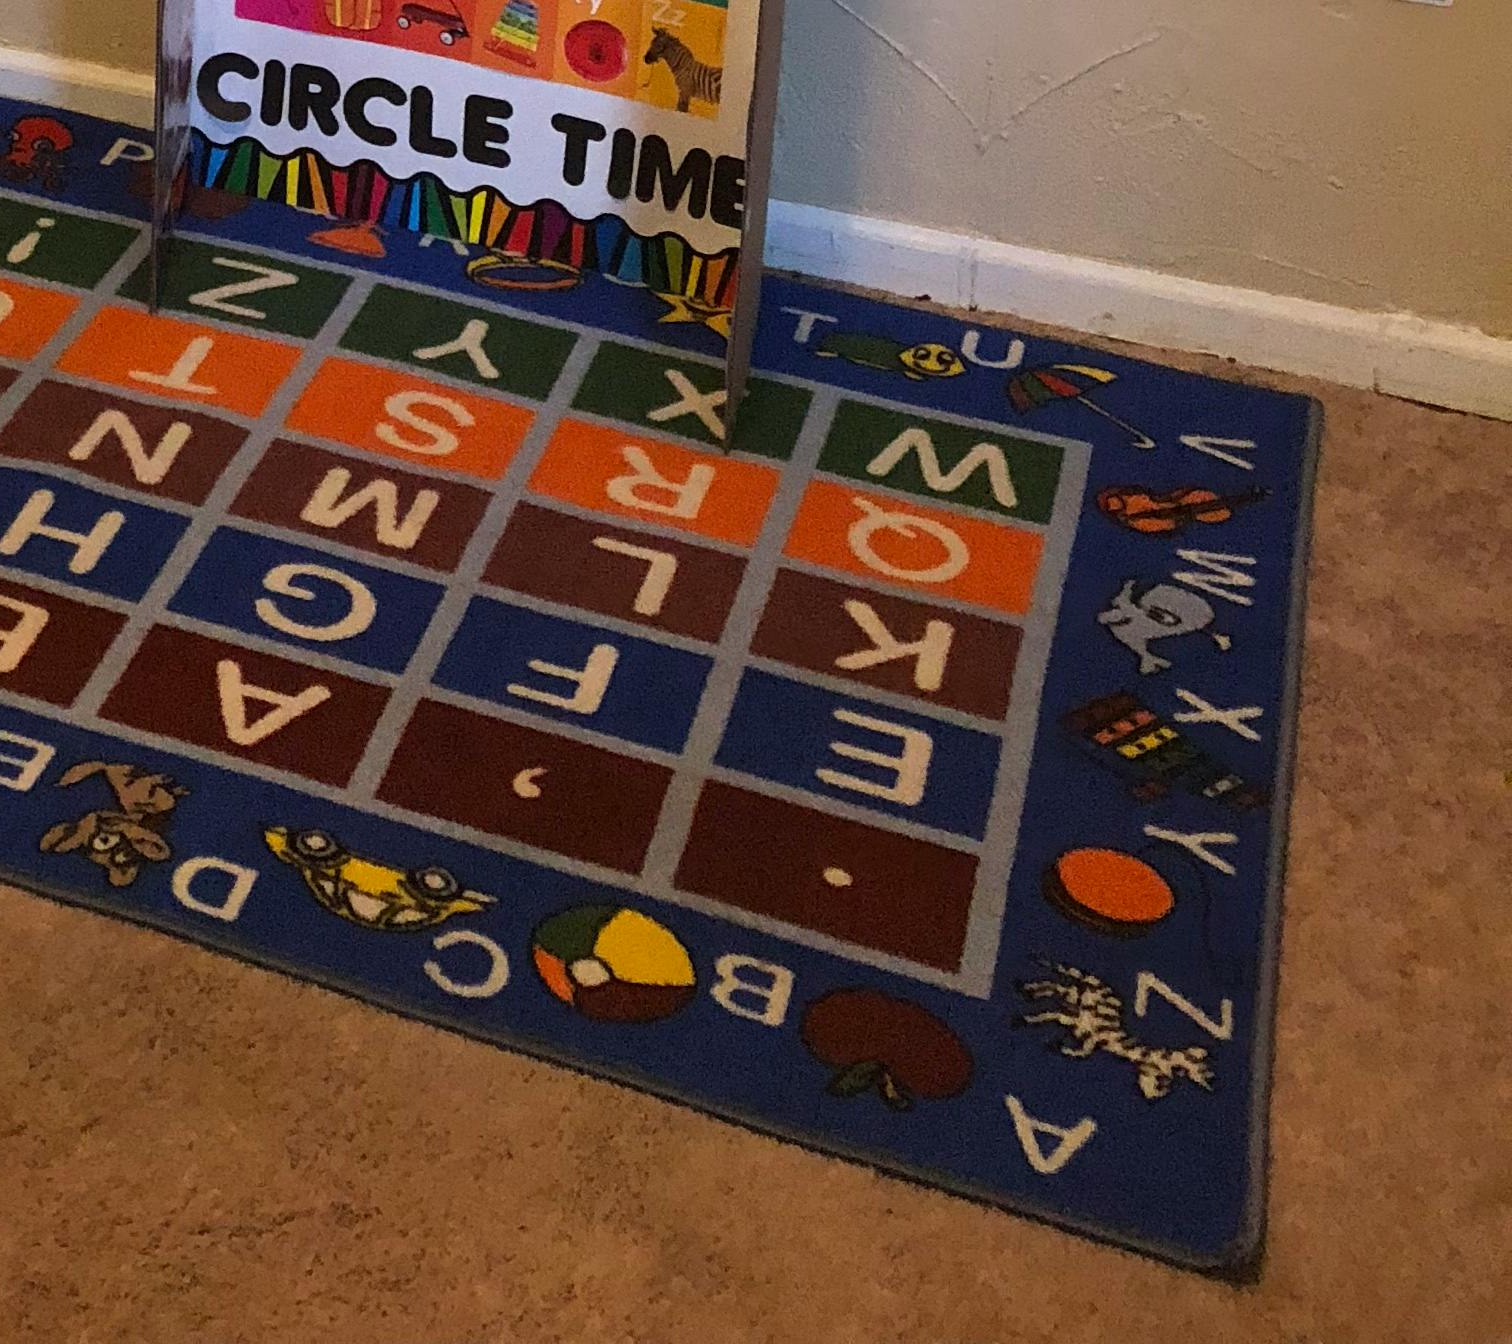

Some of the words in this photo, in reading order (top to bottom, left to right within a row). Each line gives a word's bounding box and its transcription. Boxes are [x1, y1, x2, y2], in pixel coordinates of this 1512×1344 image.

[197, 51, 515, 169] CIRCLE
[551, 112, 747, 229] TIME
[603, 444, 716, 521] R
[835, 598, 955, 694] K
[214, 656, 333, 748] A
[814, 707, 936, 806] E
